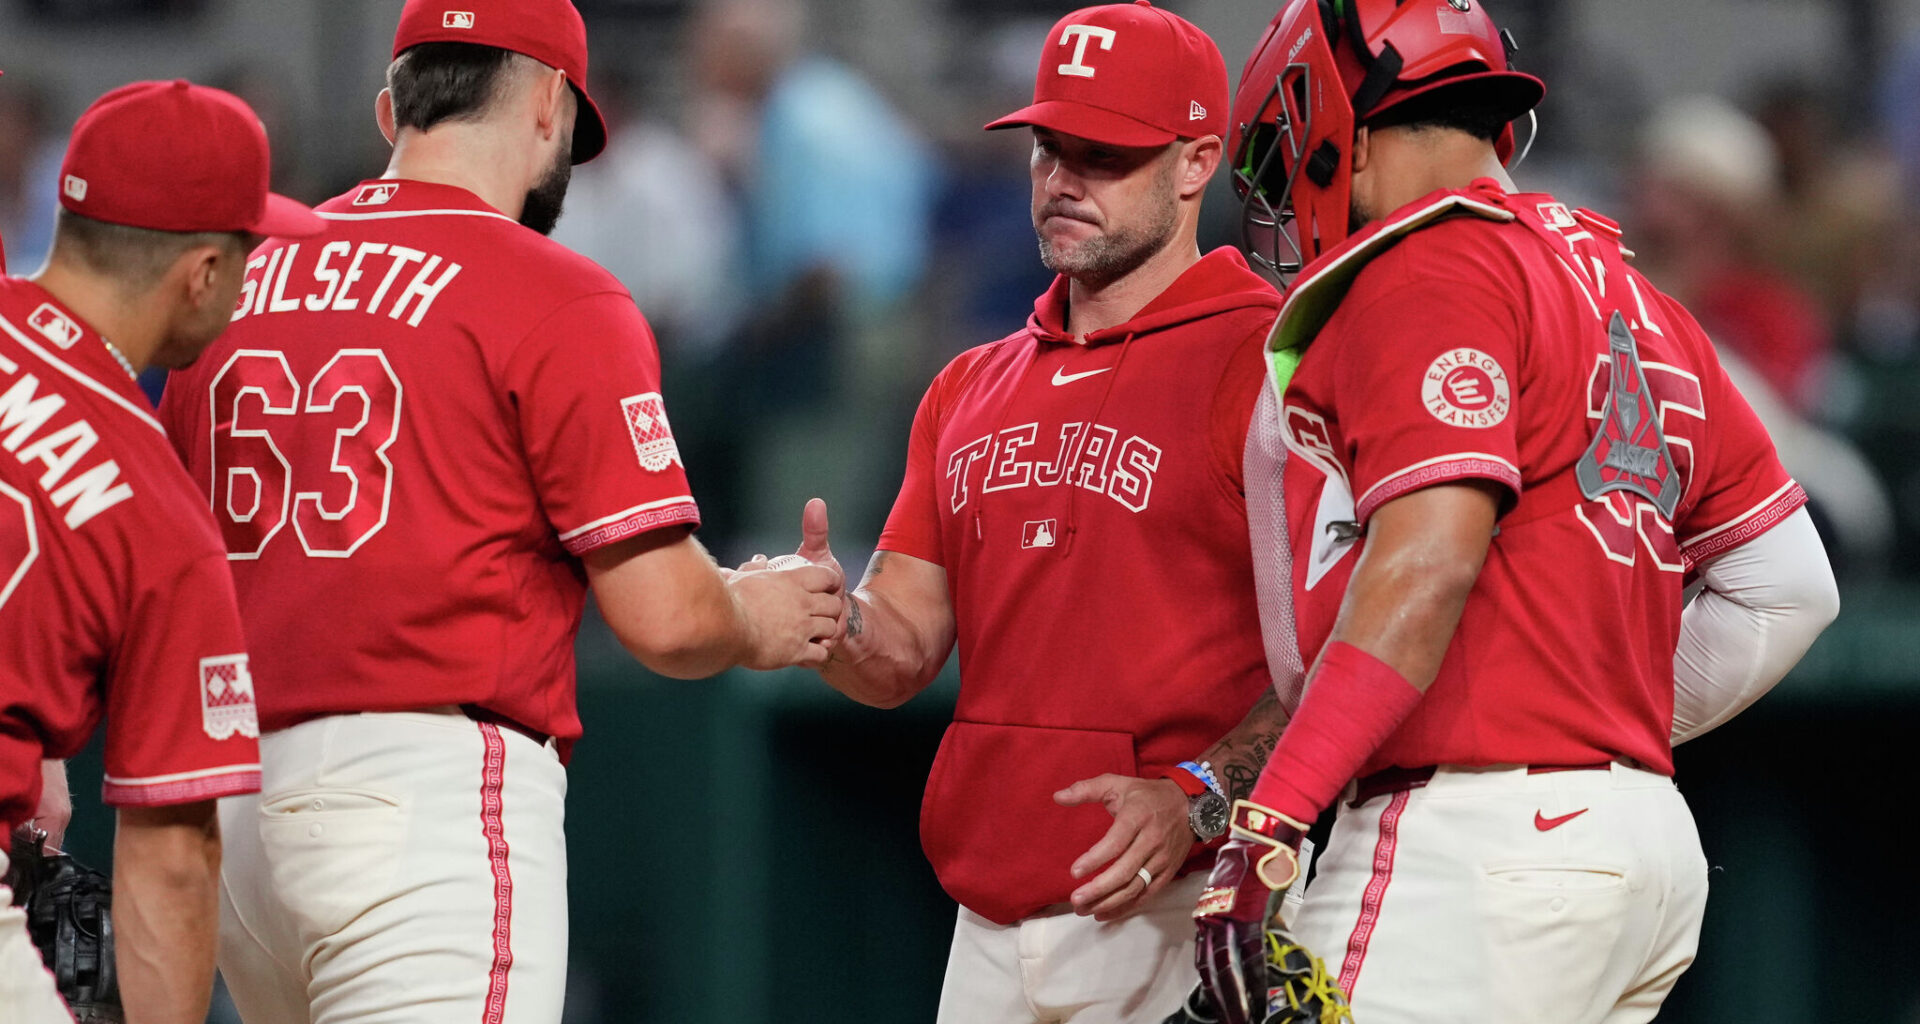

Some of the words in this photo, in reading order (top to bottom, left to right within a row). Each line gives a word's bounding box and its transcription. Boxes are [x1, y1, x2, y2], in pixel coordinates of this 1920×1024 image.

[1057, 23, 1117, 79] T
[1428, 351, 1505, 382] ENERGY
[0, 353, 134, 531] MAN
[1427, 394, 1508, 425] TRANSFER
[209, 348, 403, 561] 63
[946, 421, 1163, 514] TEJAS
